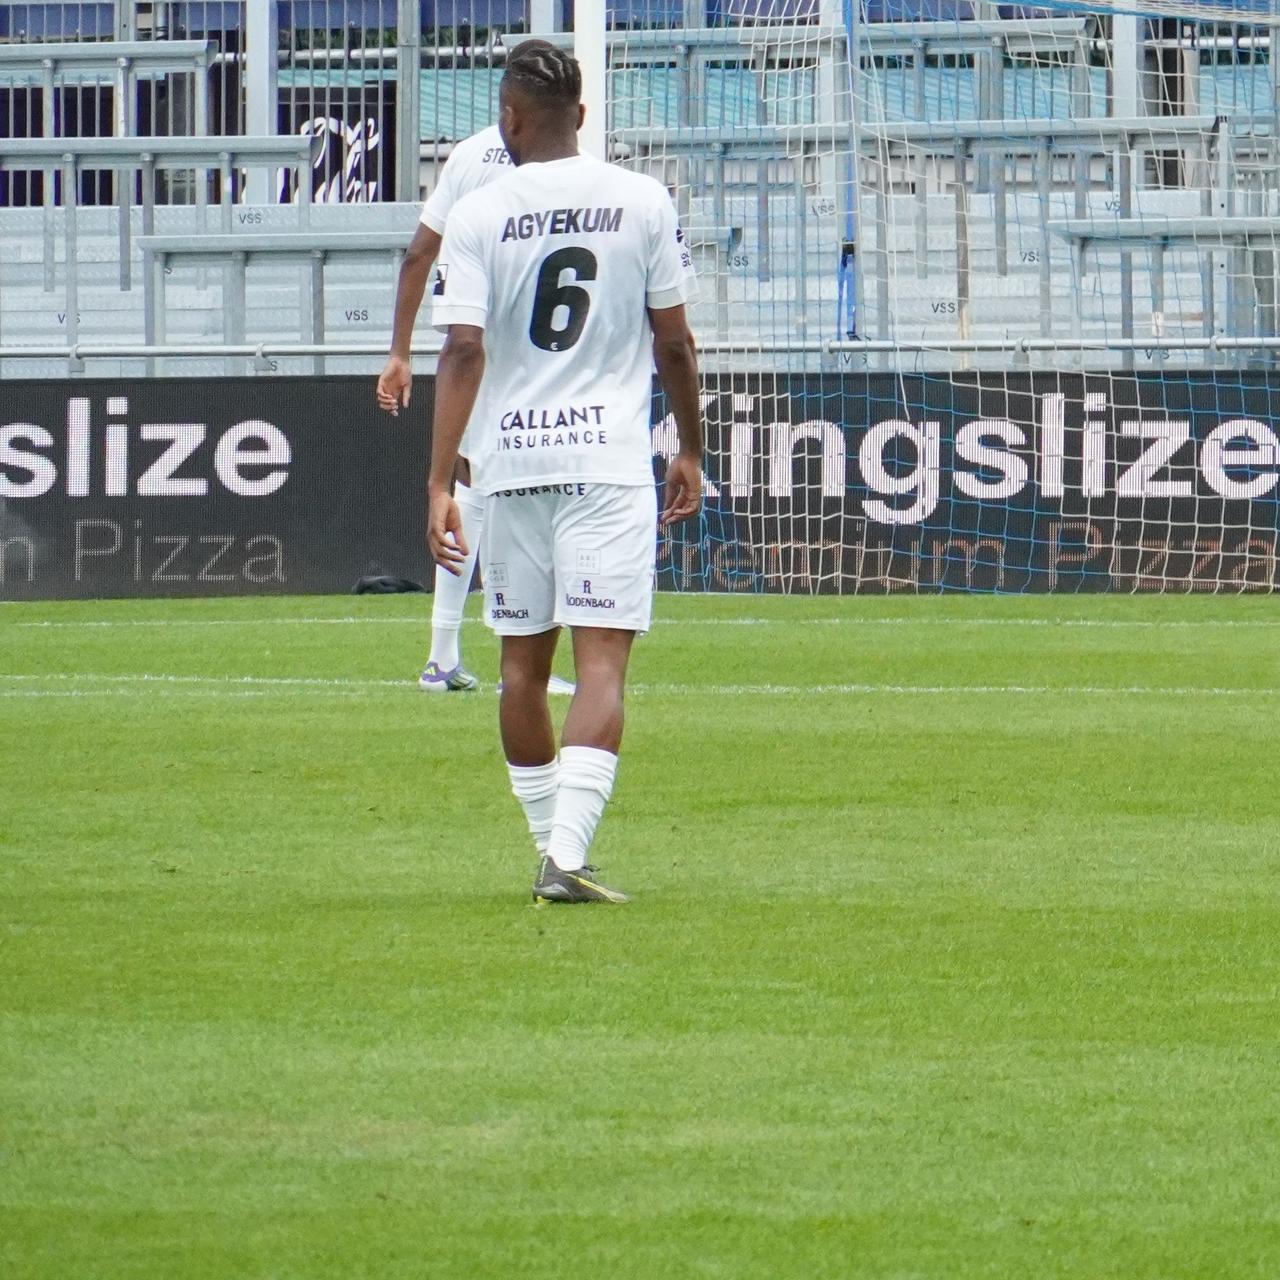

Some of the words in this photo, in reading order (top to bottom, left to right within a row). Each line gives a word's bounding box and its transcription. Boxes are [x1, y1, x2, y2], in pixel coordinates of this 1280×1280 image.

[239, 213, 262, 225] VSS
[501, 208, 624, 243] AGYEKUM
[529, 246, 598, 352] 6
[932, 302, 955, 314] VSS
[345, 310, 369, 321] VSS
[501, 406, 605, 431] CALLANT
[497, 431, 607, 451] INSURANCE
[75, 519, 286, 582] Pizza
[1049, 522, 1278, 590] Pizza
